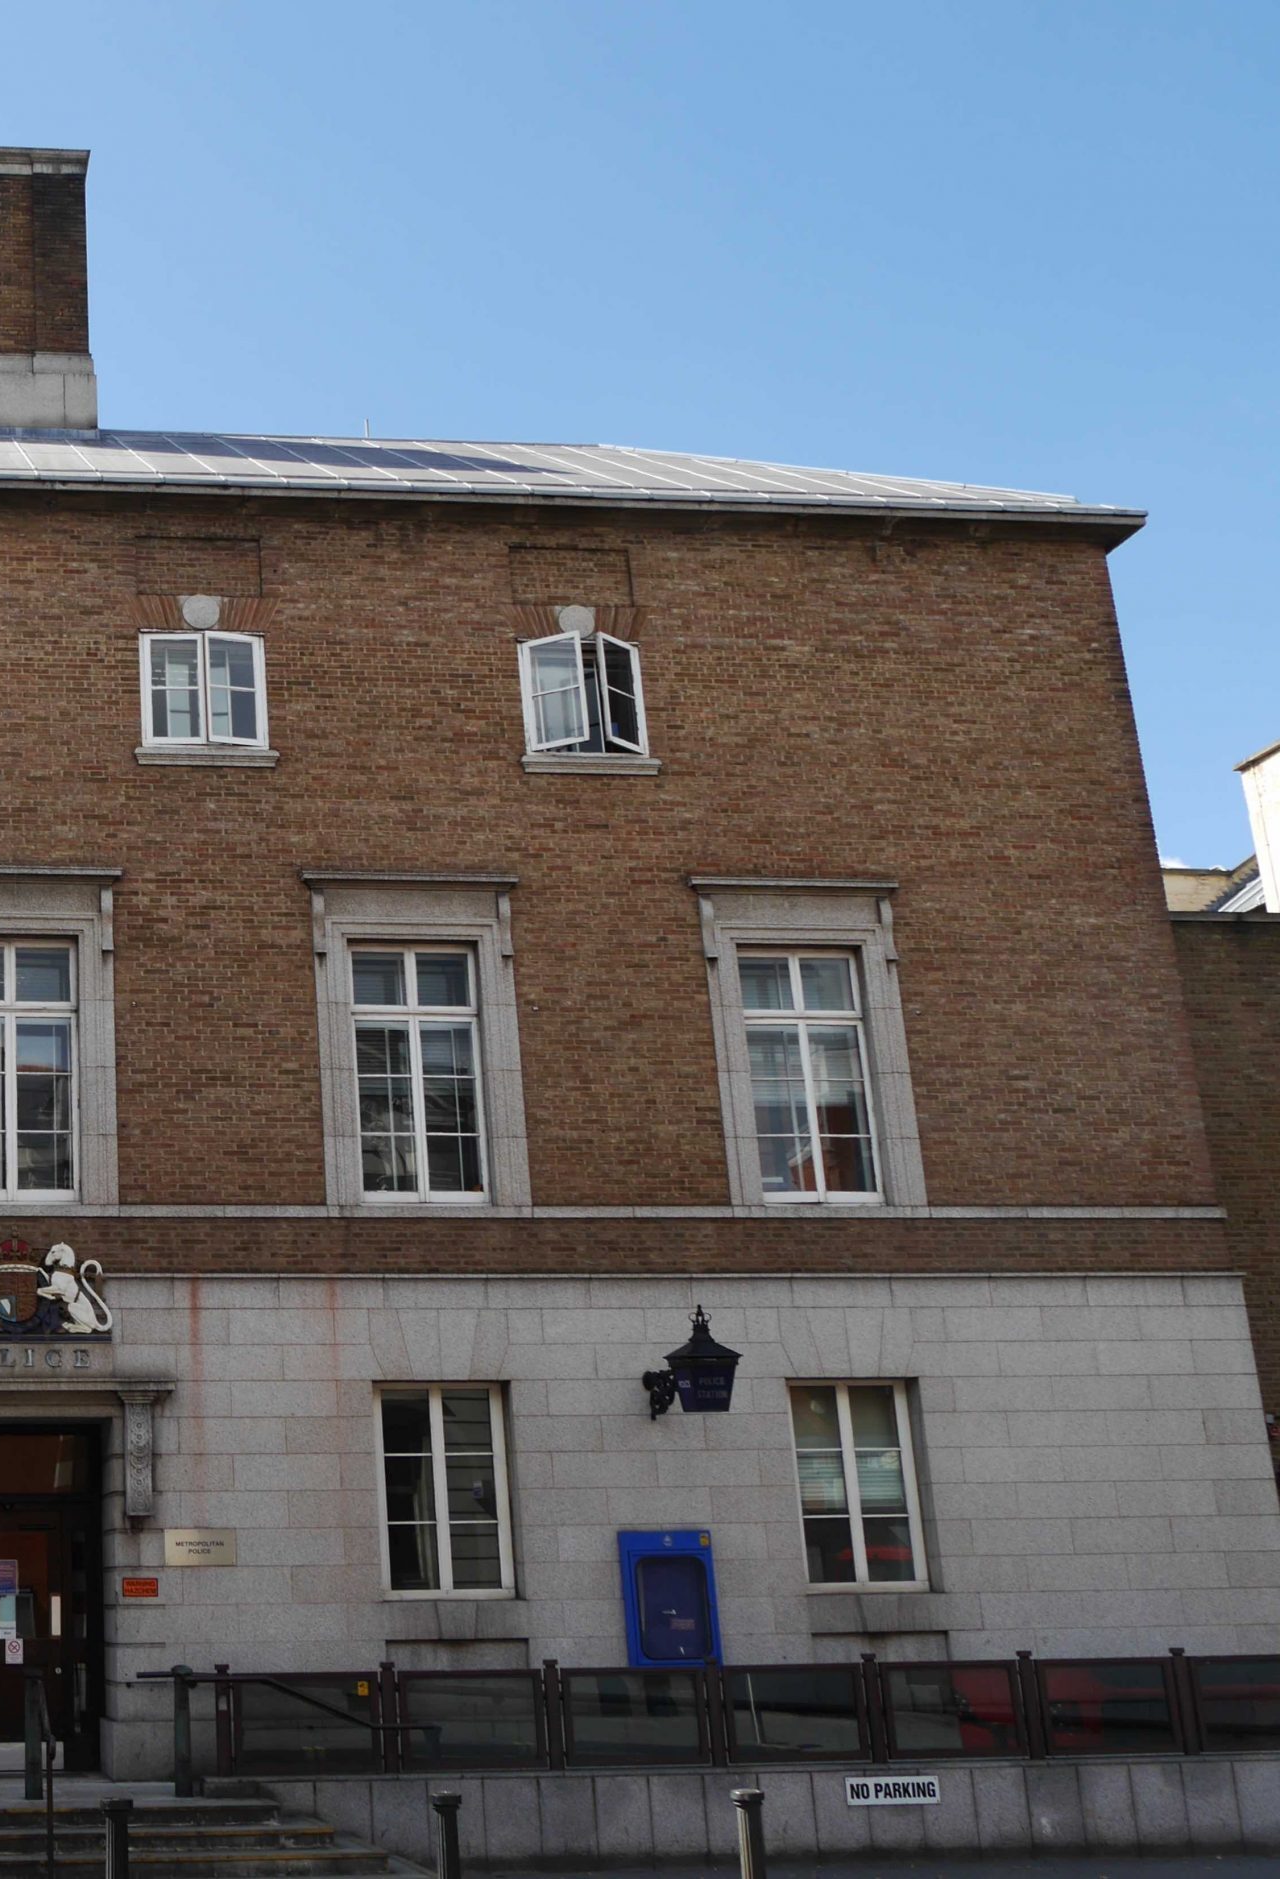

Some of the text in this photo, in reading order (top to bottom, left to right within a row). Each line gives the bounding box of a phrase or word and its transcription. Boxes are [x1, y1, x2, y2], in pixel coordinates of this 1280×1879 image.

[698, 1376, 725, 1385] POLICE
[850, 1781, 936, 1799] NO PARKING
